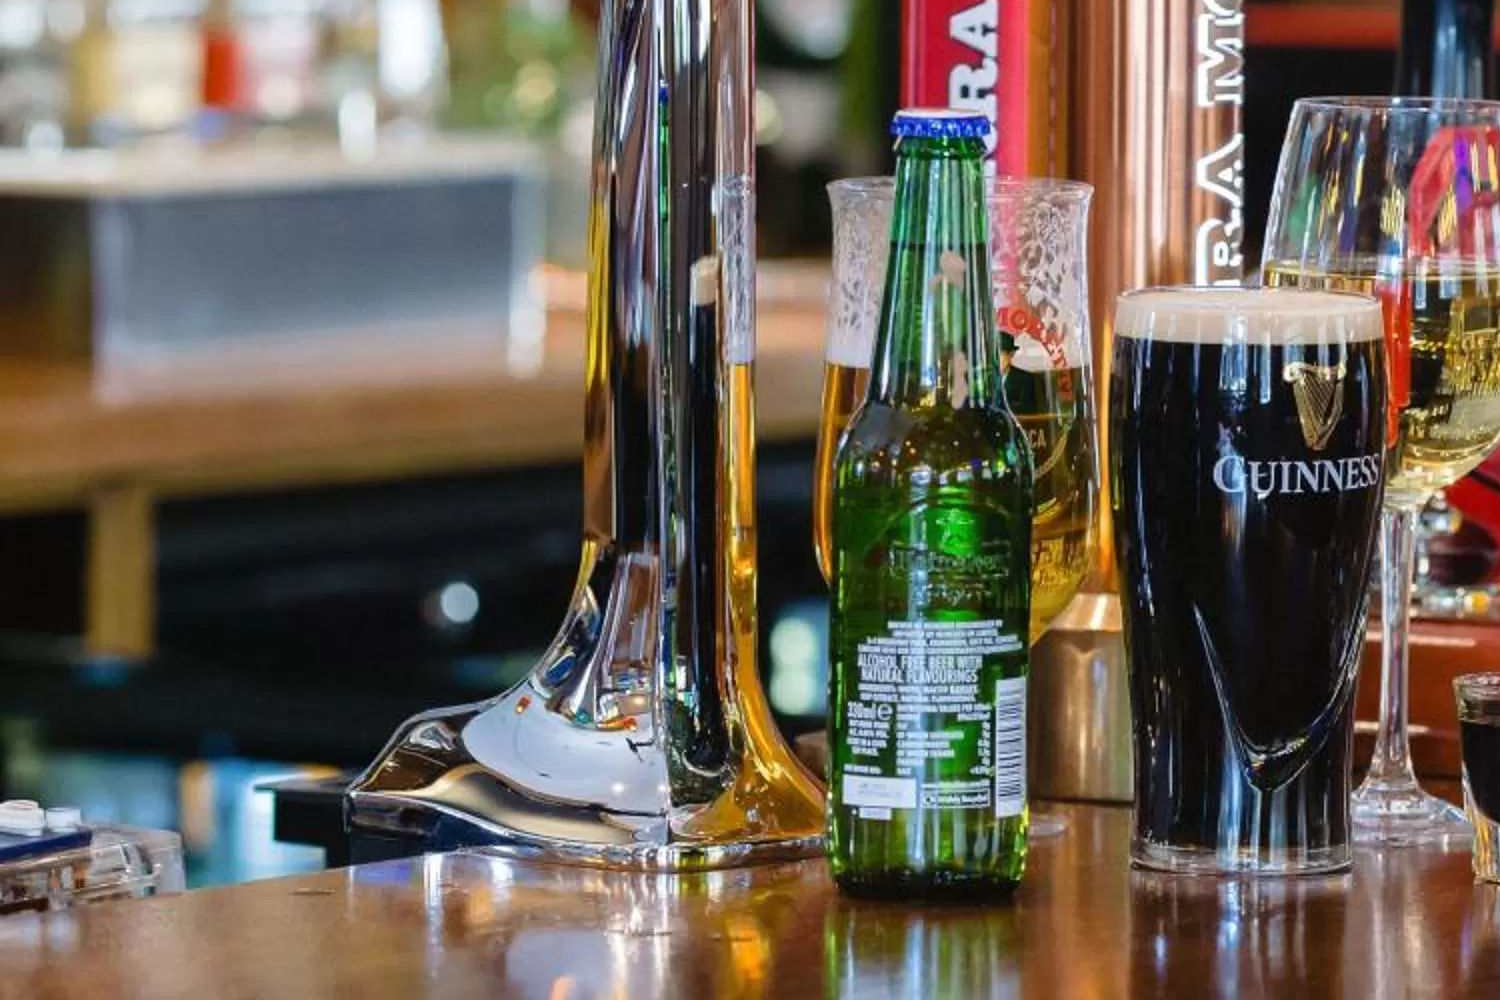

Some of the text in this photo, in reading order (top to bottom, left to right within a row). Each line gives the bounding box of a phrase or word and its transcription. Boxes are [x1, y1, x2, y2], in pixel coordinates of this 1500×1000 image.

[1213, 454, 1380, 497] GUINNESS
[858, 653, 898, 669] ALCOHOL
[901, 654, 926, 670] FREE
[928, 655, 955, 670] BEER
[861, 667, 904, 683] NATURAL
